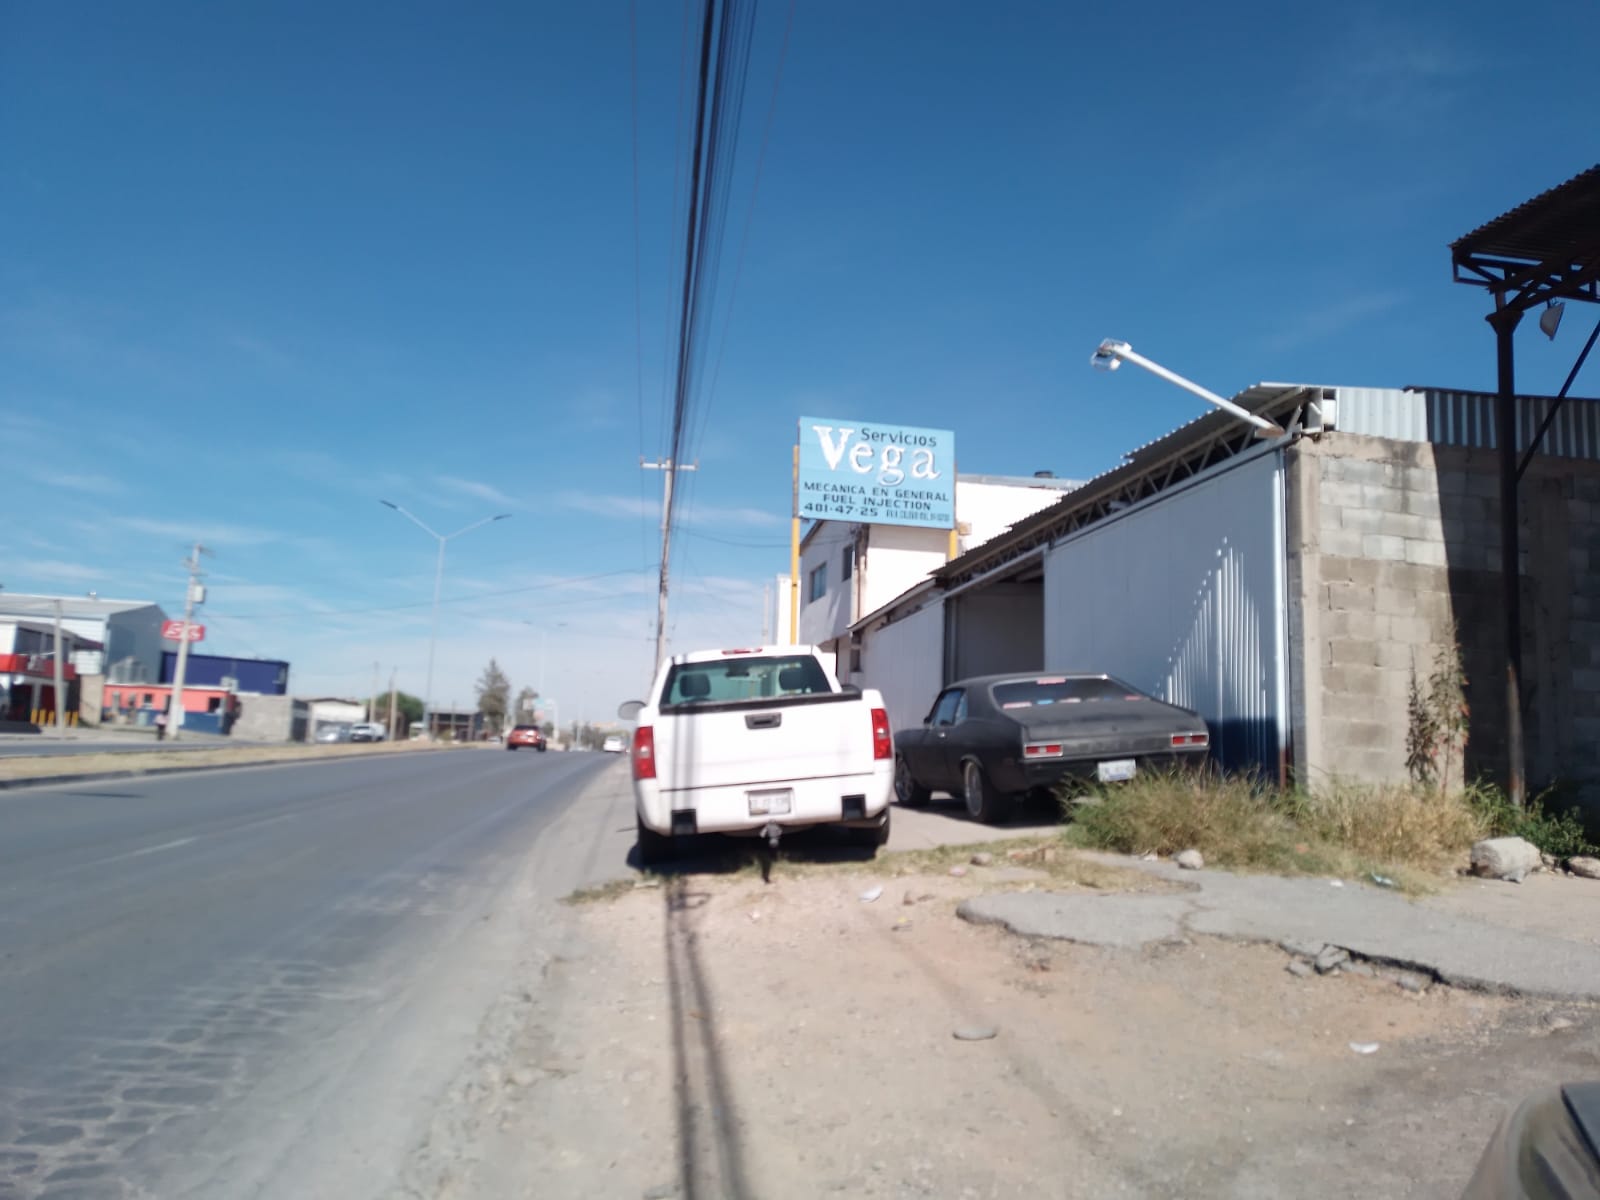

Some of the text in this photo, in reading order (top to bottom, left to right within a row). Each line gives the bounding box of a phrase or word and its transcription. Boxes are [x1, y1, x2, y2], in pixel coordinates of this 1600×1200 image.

[861, 427, 937, 447] Servicios
[812, 425, 942, 486] Vega
[804, 481, 949, 501] MECANICA EN GENERAL
[823, 493, 931, 511] FUEL INJECTION
